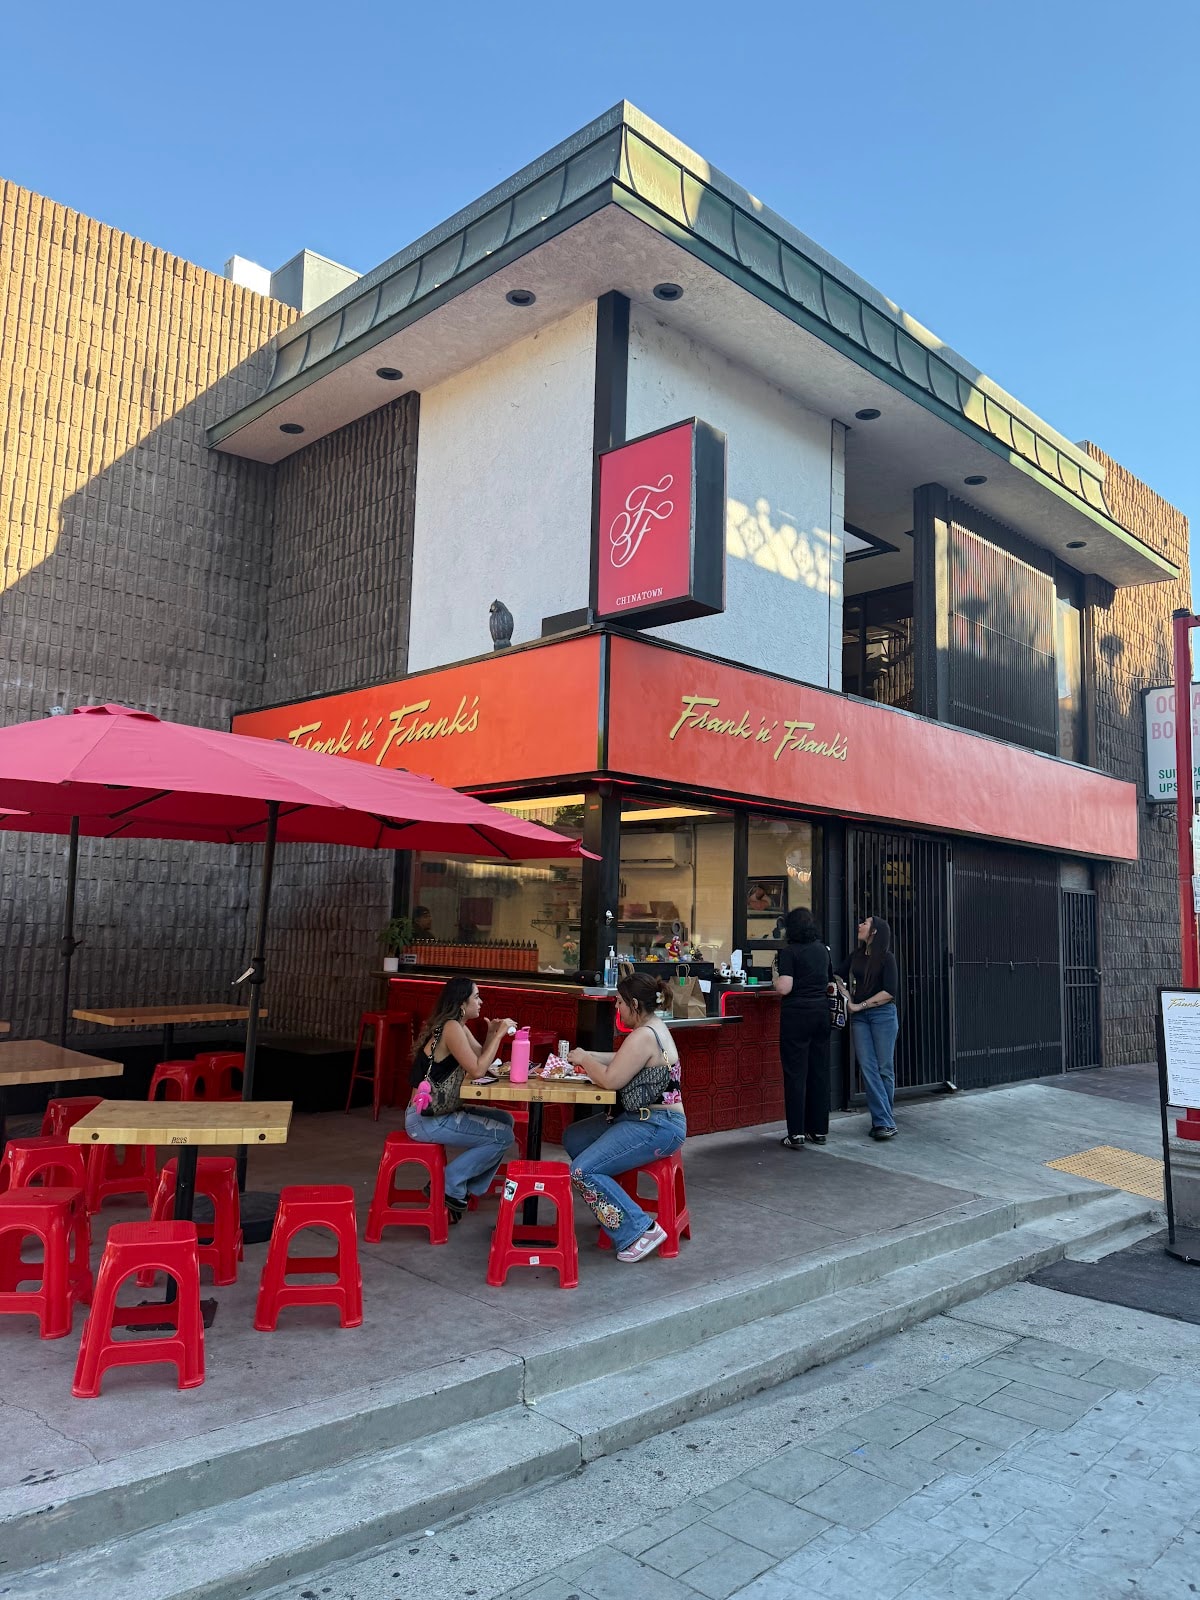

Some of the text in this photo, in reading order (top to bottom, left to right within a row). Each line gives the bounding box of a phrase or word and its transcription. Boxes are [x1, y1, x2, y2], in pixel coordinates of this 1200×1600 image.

[616, 587, 663, 606] CHINATOWN
[355, 717, 383, 751] 'n'
[375, 695, 480, 766] Frank's
[669, 694, 849, 761] Frank 'n' Frank's
